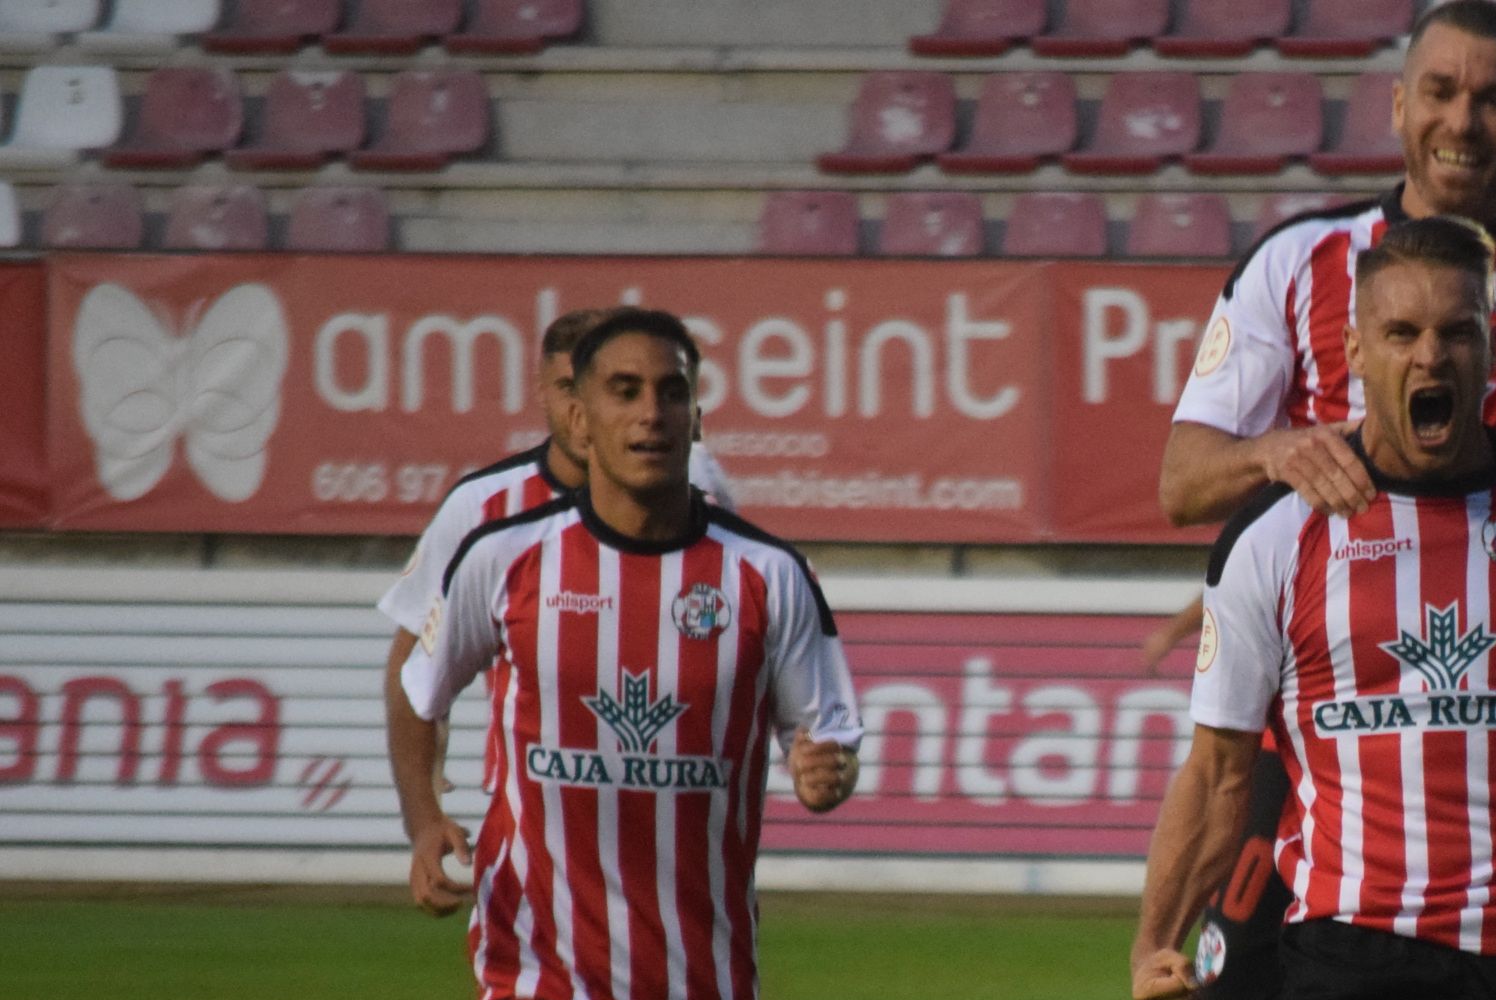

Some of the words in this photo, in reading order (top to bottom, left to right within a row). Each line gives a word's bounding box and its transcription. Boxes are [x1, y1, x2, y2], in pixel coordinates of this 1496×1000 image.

[313, 288, 1021, 420] amseint
[1335, 538, 1412, 560] uhlsport
[546, 594, 613, 612] uhlsport
[1314, 699, 1417, 732] CAJA
[528, 748, 612, 784] CAJA
